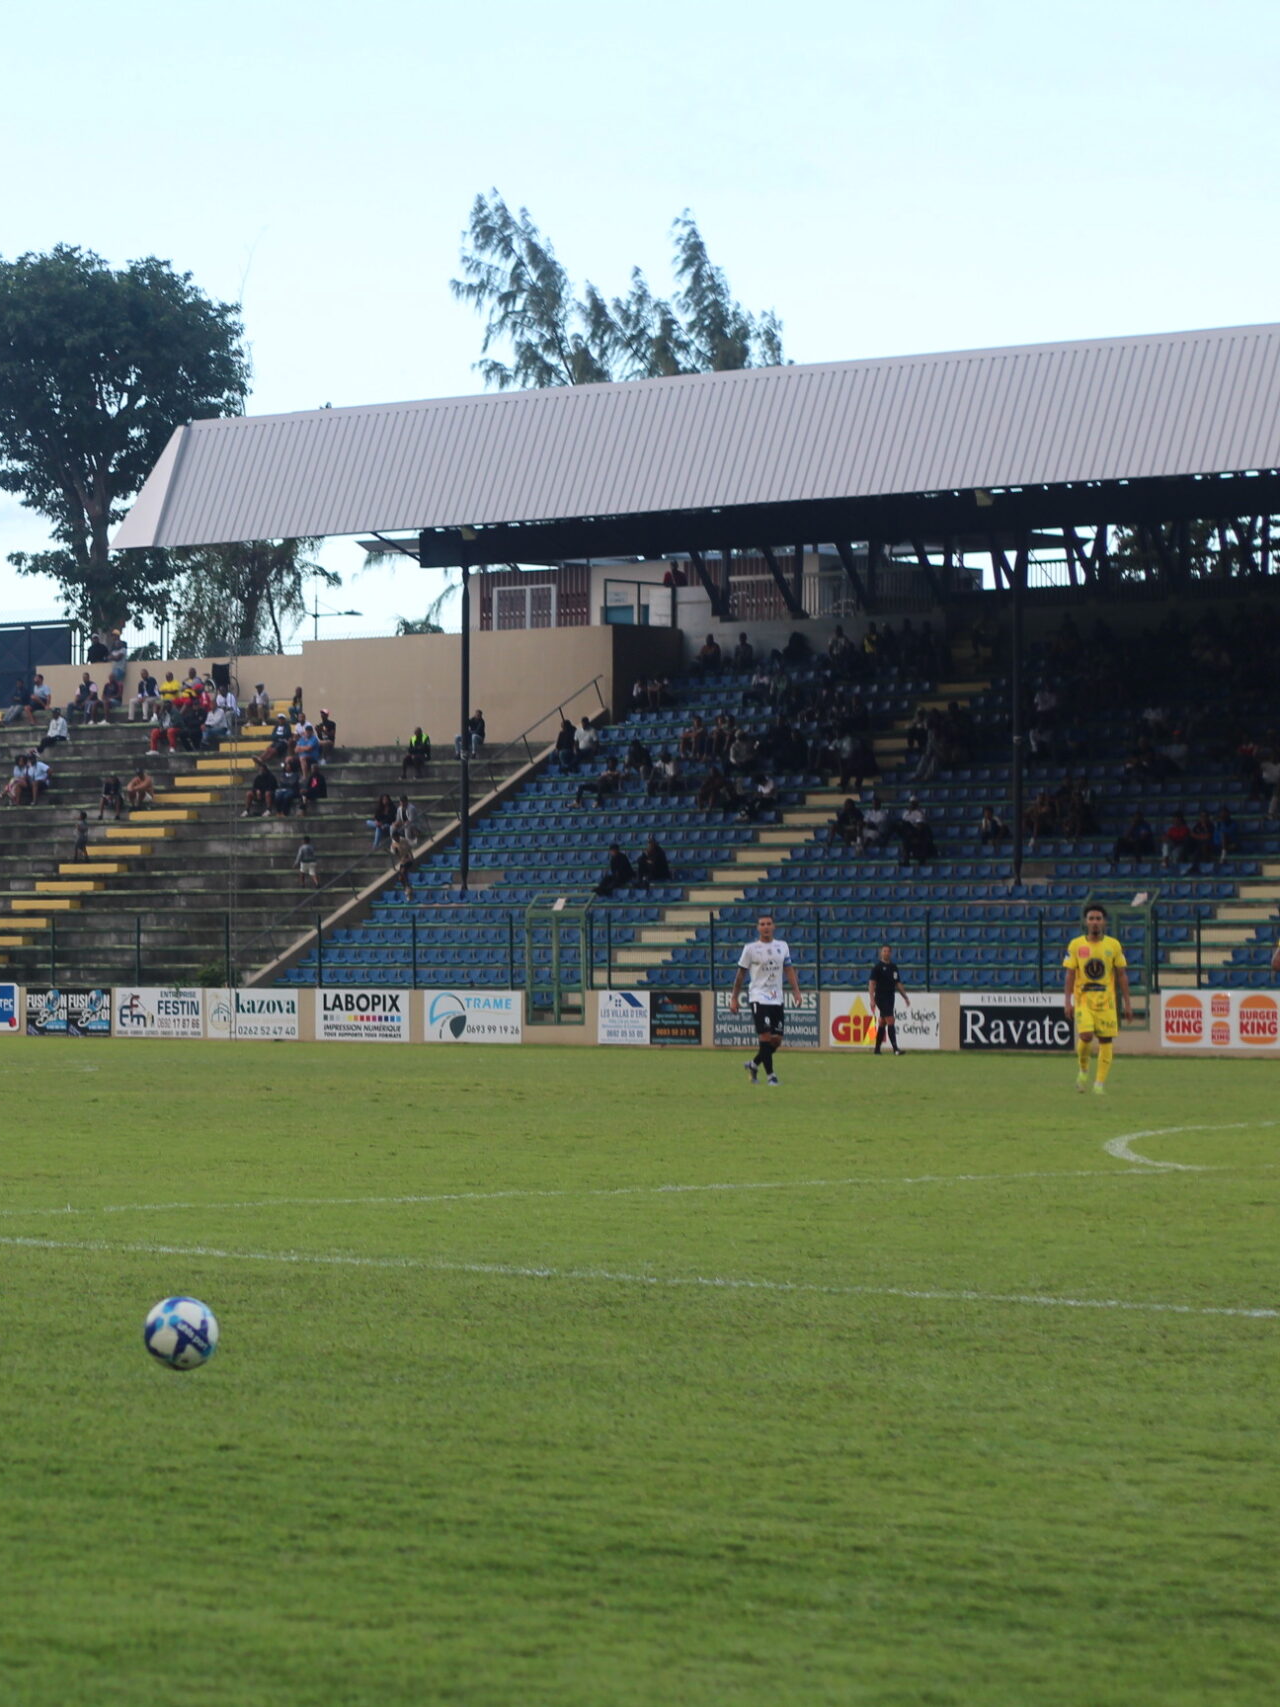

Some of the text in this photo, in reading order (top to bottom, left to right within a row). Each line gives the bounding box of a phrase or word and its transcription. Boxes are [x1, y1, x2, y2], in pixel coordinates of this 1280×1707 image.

[27, 990, 67, 1012] FUSION
[68, 990, 110, 1012] FUSION
[235, 992, 297, 1014] kazova
[323, 993, 401, 1012] LABOPIX
[465, 998, 513, 1010] TRAME
[981, 996, 1053, 1004] ETABLISSEMENT
[157, 1001, 200, 1015] FESTIN
[600, 1009, 611, 1018] LES
[611, 1009, 629, 1018] VILLAS
[1165, 1009, 1202, 1019] BURGER
[1240, 1010, 1277, 1020] BURGER
[238, 1026, 296, 1036] 0262 52 47 40
[466, 1024, 486, 1034] 0693
[487, 1024, 497, 1034] 99
[499, 1024, 508, 1034] 19
[963, 1009, 1071, 1045] Ravate
[1165, 1020, 1202, 1033] KING
[1240, 1021, 1277, 1035] KING
